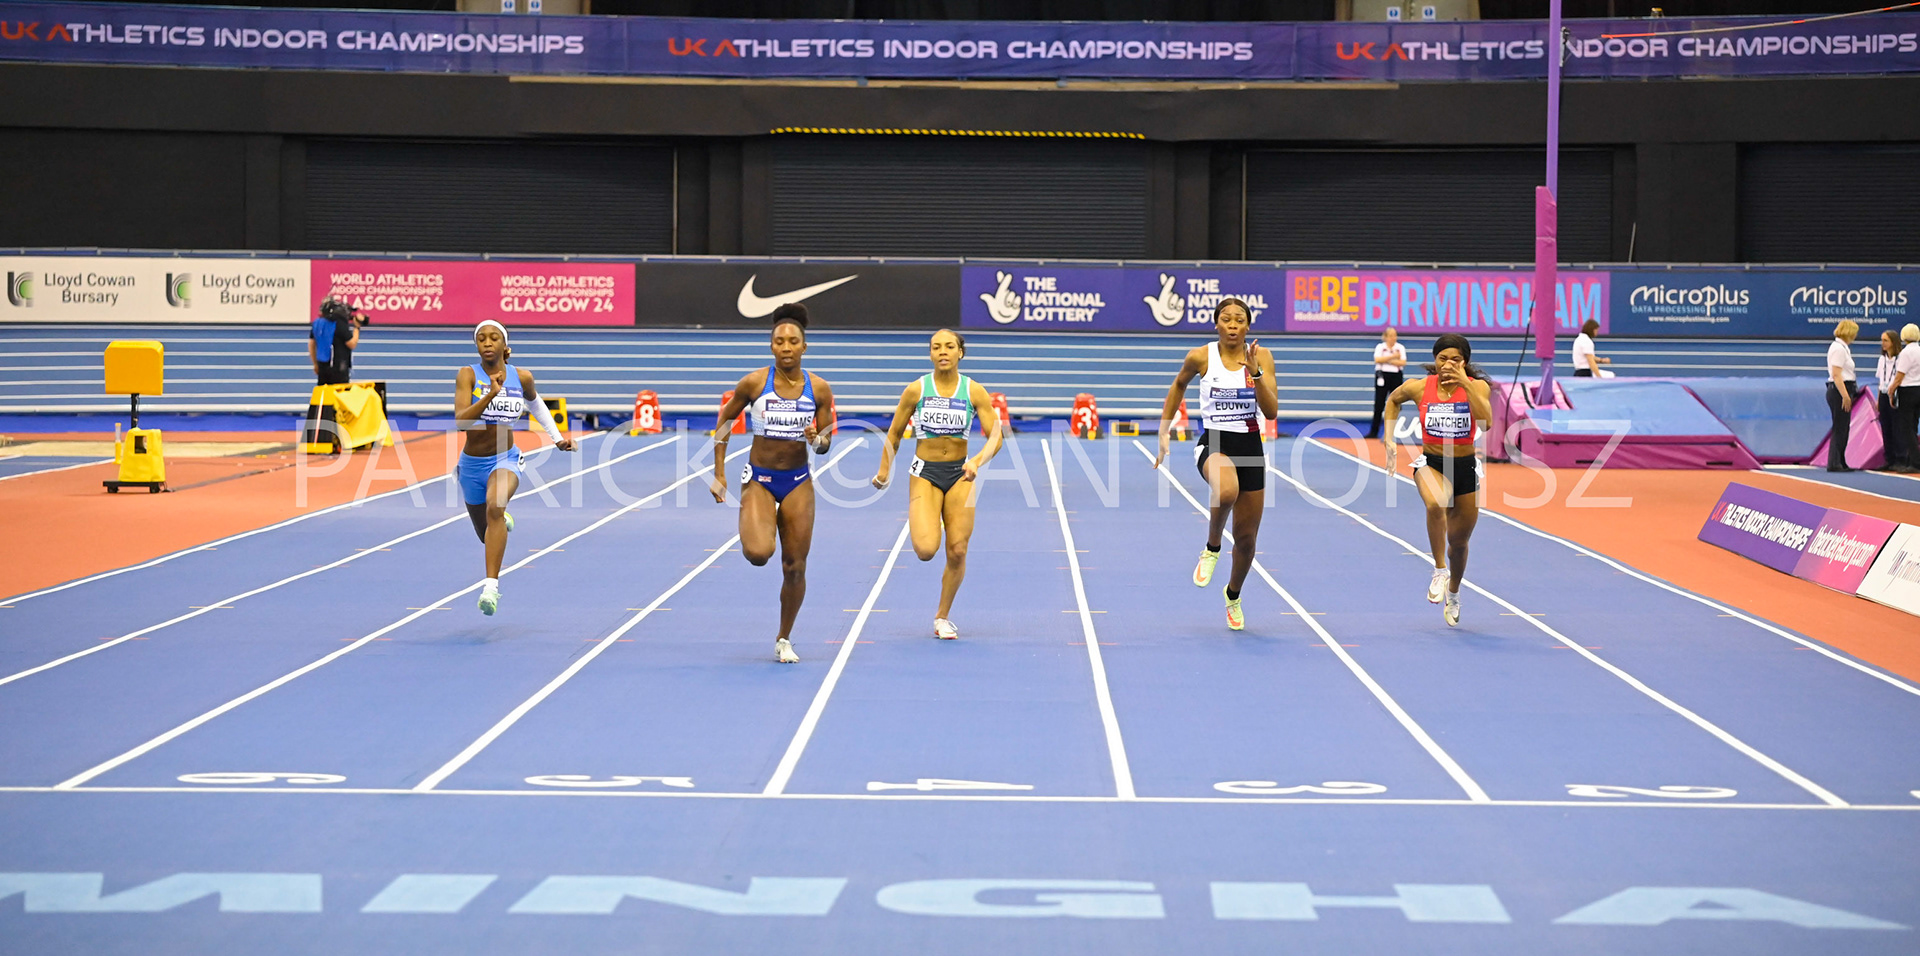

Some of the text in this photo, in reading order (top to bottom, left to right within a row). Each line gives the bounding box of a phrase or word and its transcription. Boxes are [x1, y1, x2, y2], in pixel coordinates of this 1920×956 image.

[1, 21, 584, 54] UK ATHLETICS INDOOR CHAMPIONSHIPS
[668, 38, 1253, 61] UK ATHLETICS INDOOR CHAMPIONSHIPS
[1336, 33, 1917, 61] UK ATHLETICS NDOOR CHAMPIONSHIPS
[44, 272, 135, 290] Lloyd Cowan
[202, 274, 295, 292] Lloyd Cowan
[330, 273, 443, 286] WORLD ATHLETICS
[501, 275, 615, 288] WORLD ATHLETICS
[1023, 277, 1057, 291] THE
[1187, 279, 1219, 293] THE
[1294, 276, 1320, 300] BE
[1321, 276, 1359, 313] BE
[62, 290, 119, 307] Bursary
[220, 291, 278, 308] Bursary
[422, 296, 443, 311] 24
[501, 297, 614, 312] GLASGOW 24
[1024, 292, 1105, 308] NATIONAL
[1024, 307, 1097, 322] LOTTERY
[1631, 305, 1652, 314] DATA
[1655, 306, 1705, 314] PROCESSING
[1719, 306, 1748, 314] TIMING
[1791, 306, 1812, 314] DATA
[1814, 307, 1864, 315] PROCESSING
[1877, 307, 1906, 315] TIMING
[640, 404, 654, 428] 8
[767, 415, 812, 427] WILLIAMS
[923, 411, 964, 425] SKERVIN
[1078, 407, 1092, 429] 3
[1427, 416, 1469, 428] ZINTCHEM
[911, 460, 919, 473] 4
[176, 771, 347, 784] 6
[523, 774, 695, 787] 5
[866, 778, 1033, 792] 4
[1213, 781, 1388, 796] 3
[1564, 783, 1738, 799] 2
